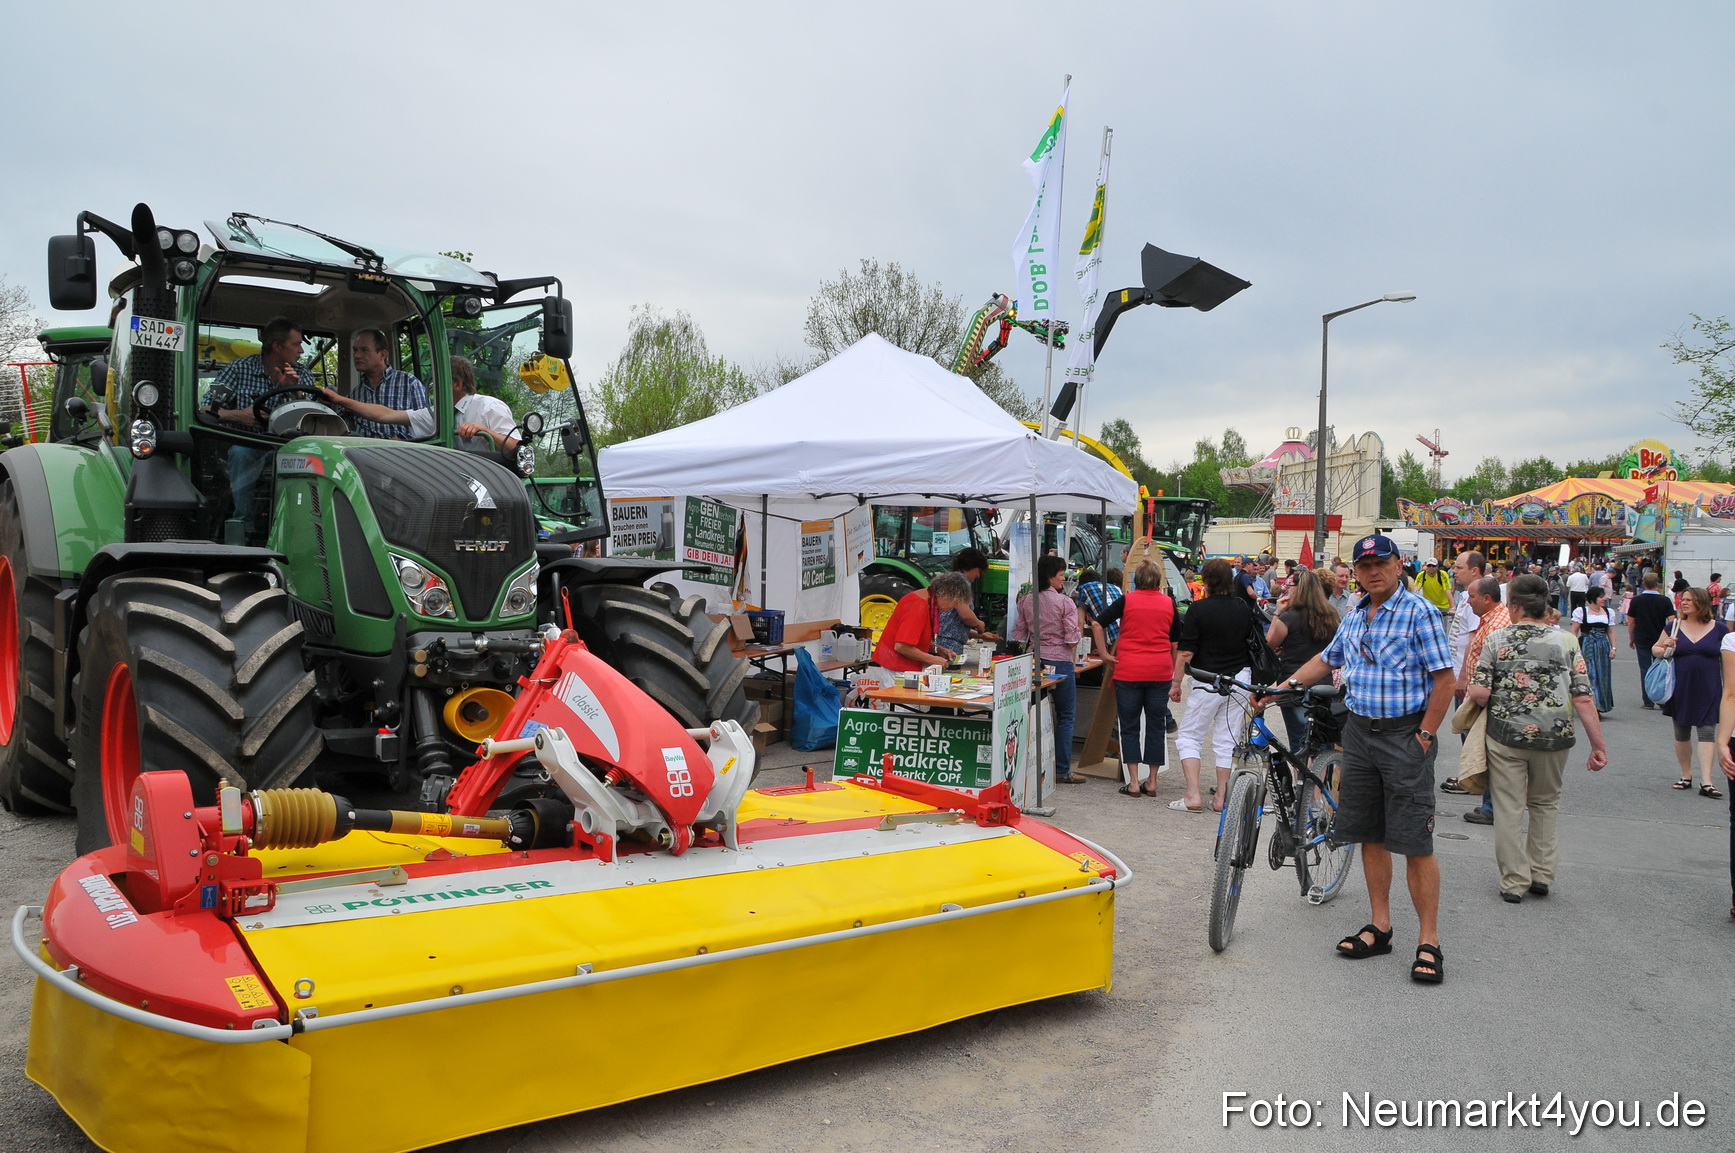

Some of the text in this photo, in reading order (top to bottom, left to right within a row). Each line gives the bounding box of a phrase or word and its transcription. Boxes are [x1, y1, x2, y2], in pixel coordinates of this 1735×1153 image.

[140, 319, 166, 334] SAD
[135, 329, 180, 349] XH 447
[612, 505, 648, 521] BAUERN
[613, 523, 635, 531] brauchen
[700, 516, 722, 531] FREIER
[613, 531, 657, 548] FAIREN PREIS
[695, 525, 725, 544] Landkreis
[802, 536, 822, 547] BAUERN
[453, 539, 510, 552] FENDT
[687, 548, 700, 560] GIB
[701, 551, 719, 563] DEIN
[720, 555, 732, 565] JA!
[802, 569, 825, 587] 40 Cent
[572, 694, 599, 720] classic
[884, 735, 951, 755] FREIER
[867, 766, 927, 782] Nemarkt
[937, 772, 963, 784] OPf.
[78, 874, 128, 914] EUROCAT
